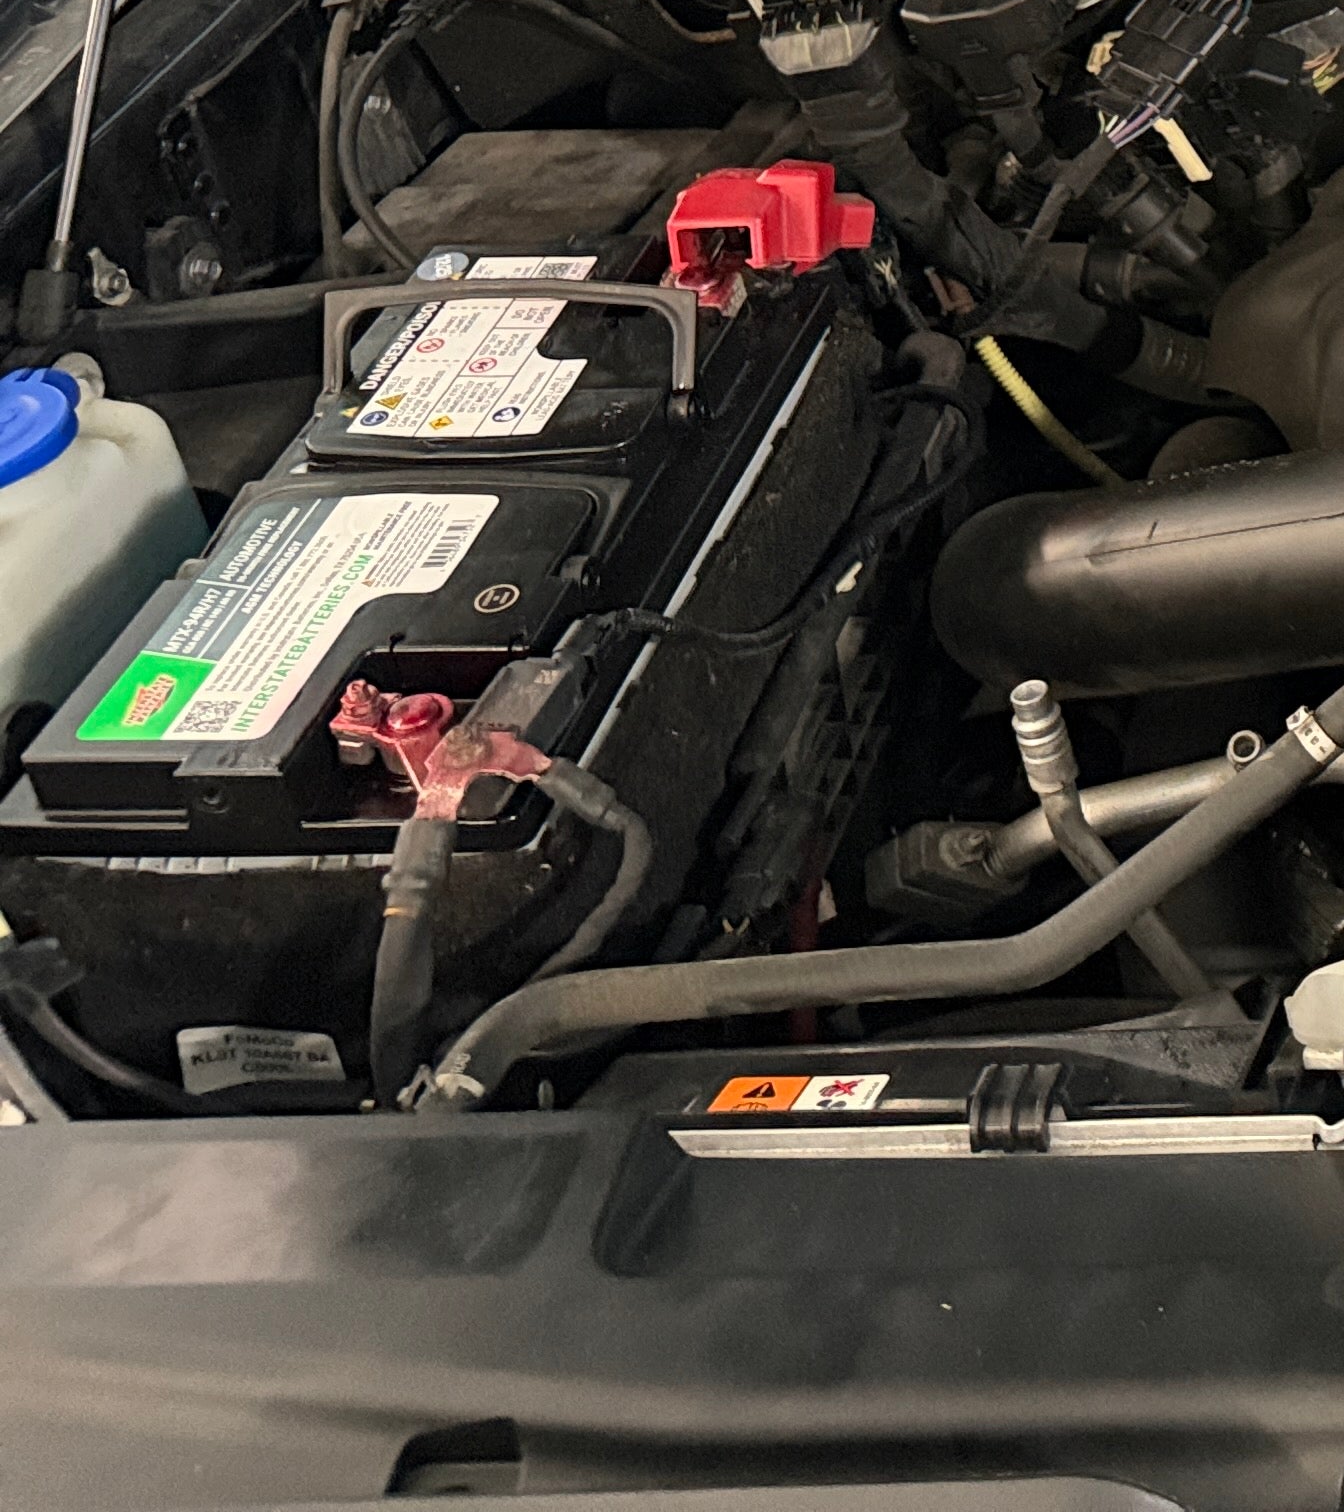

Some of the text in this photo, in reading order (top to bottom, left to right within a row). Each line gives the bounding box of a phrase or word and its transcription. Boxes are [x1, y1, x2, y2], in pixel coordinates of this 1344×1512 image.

[217, 518, 280, 580] AUTOMOTIVE
[237, 541, 305, 613] AGM TECHNOLOGY
[161, 587, 224, 652] MTX-94R/H7
[230, 554, 375, 732] INTERSTATEBATTERIES.COM
